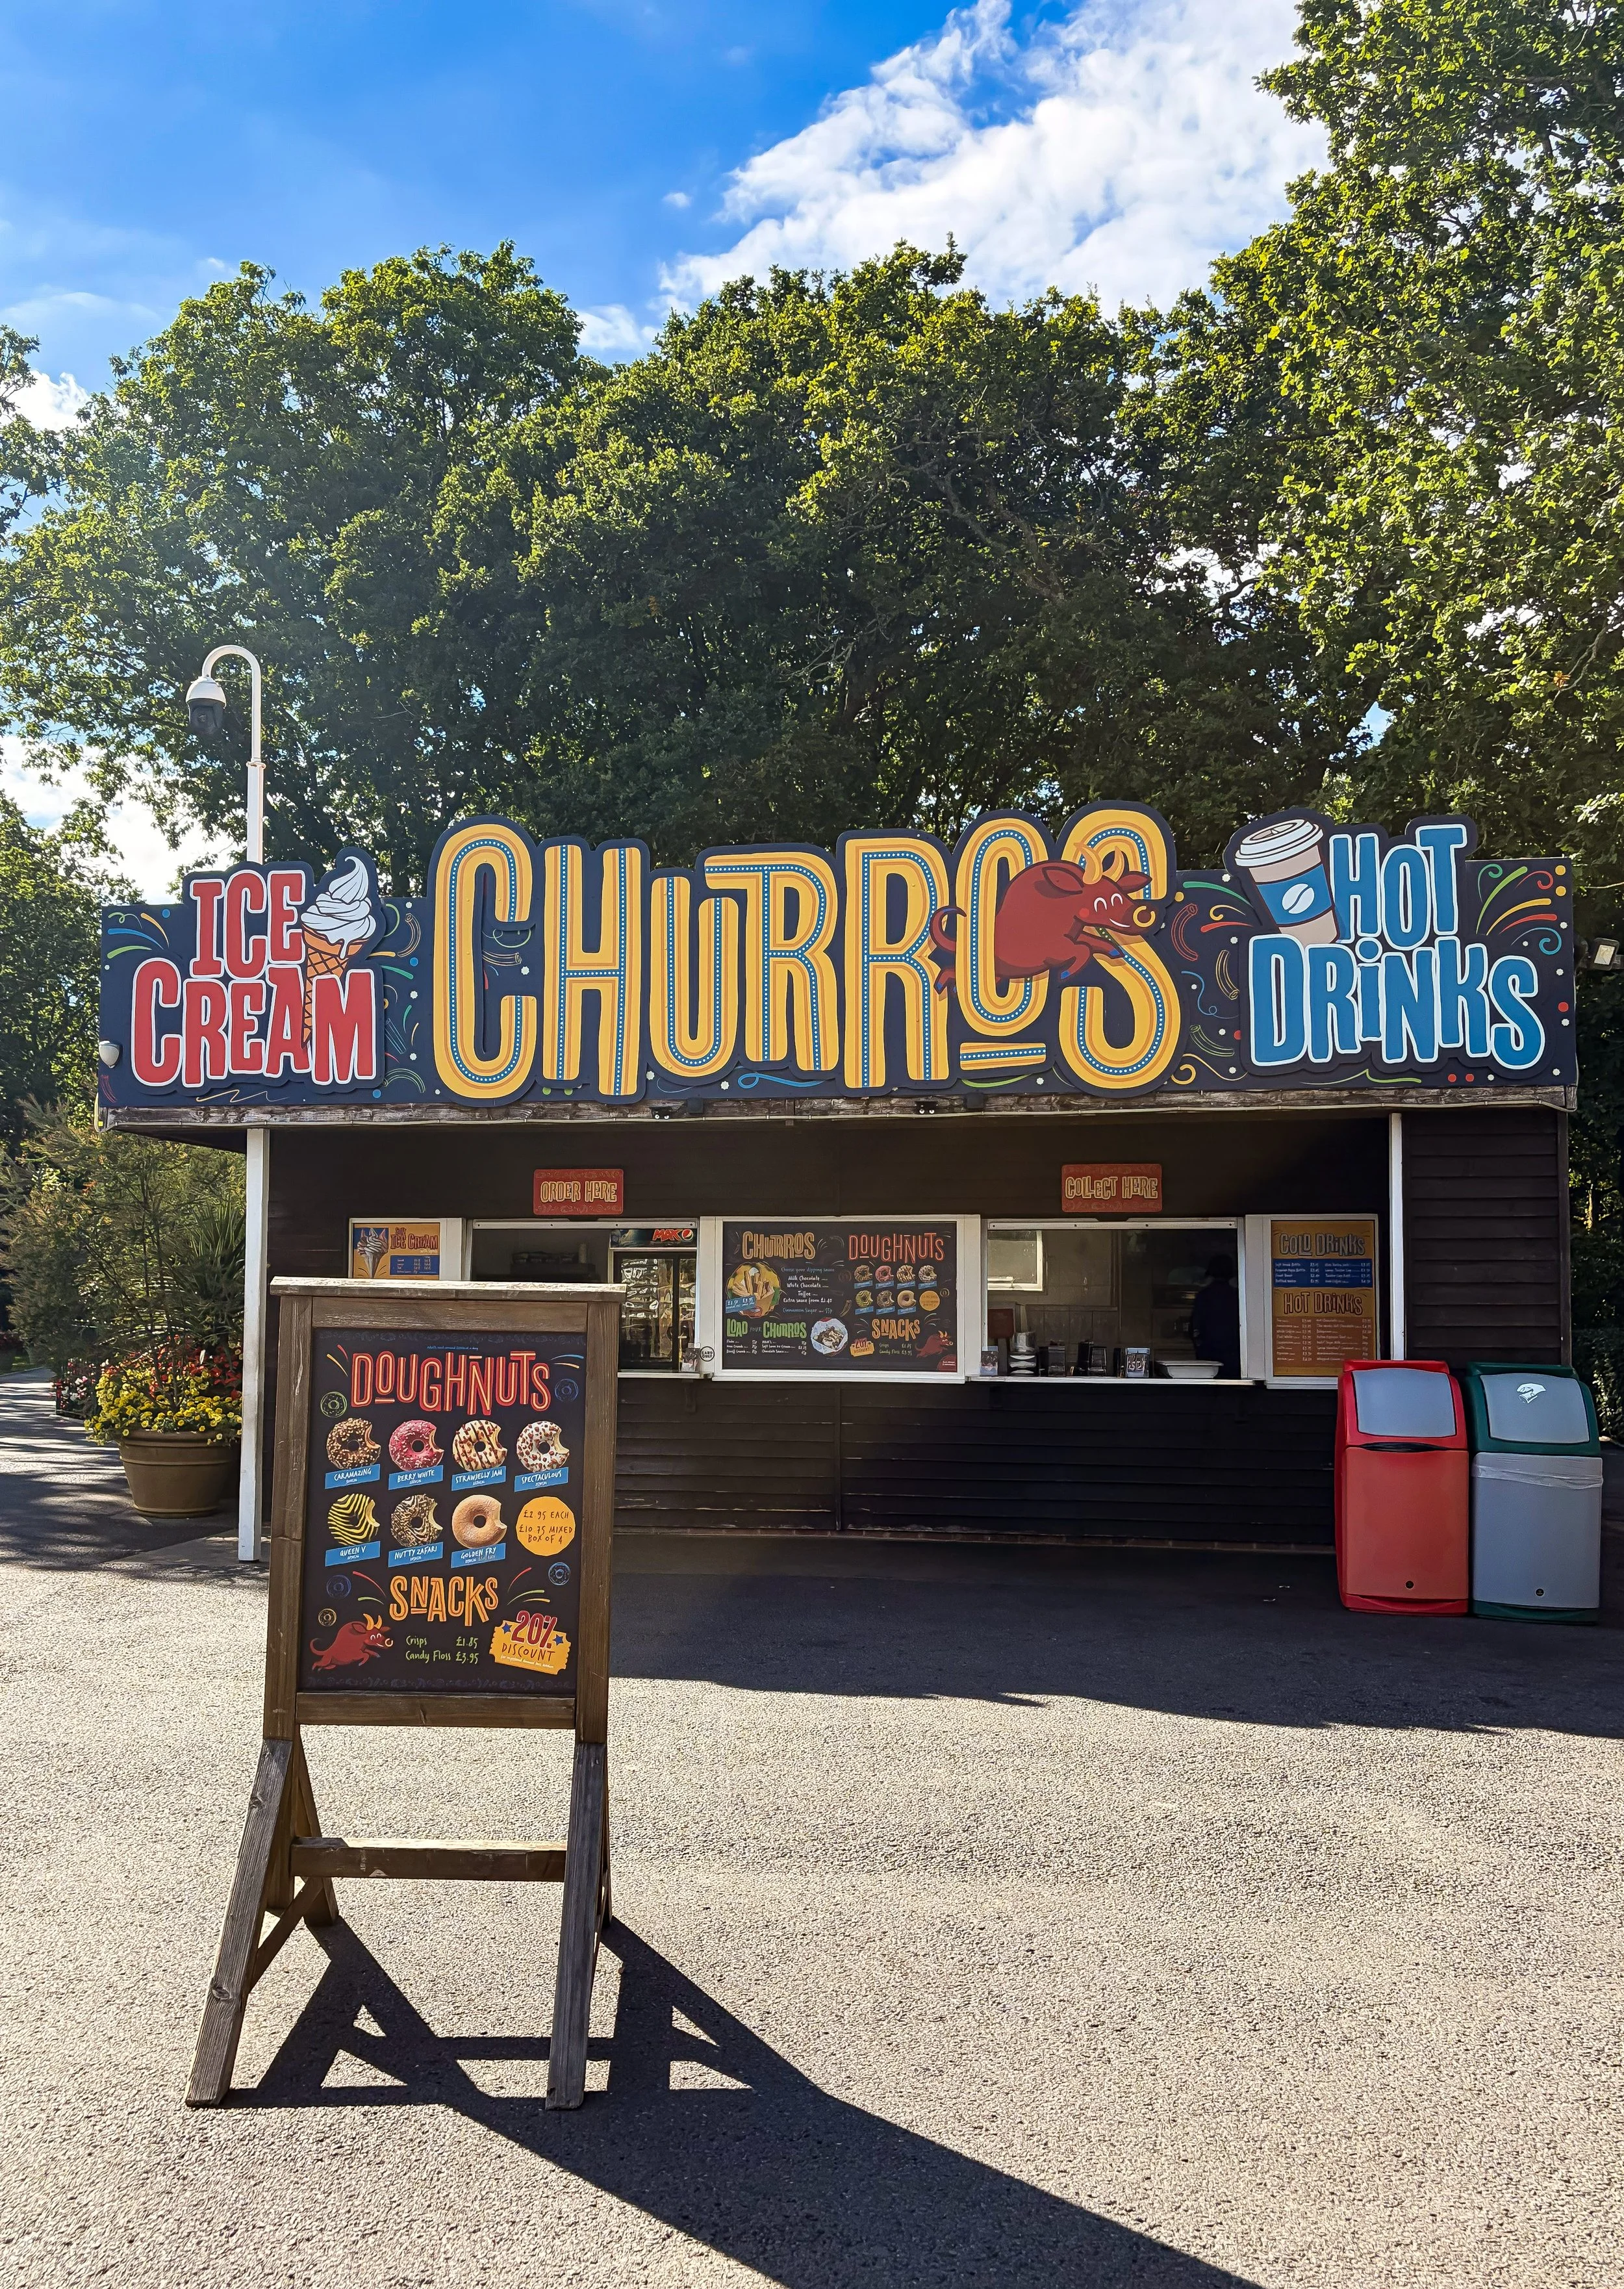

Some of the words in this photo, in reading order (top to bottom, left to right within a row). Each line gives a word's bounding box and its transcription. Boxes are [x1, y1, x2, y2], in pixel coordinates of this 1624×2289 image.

[1329, 824, 1467, 951] HOT
[190, 869, 306, 978] ICE
[433, 810, 1181, 1099] CHURROS
[131, 956, 377, 1087] CREAM
[540, 1181, 581, 1203] ORDER
[585, 1181, 616, 1202] HERE
[1065, 1176, 1117, 1199] COLLECT
[1122, 1177, 1158, 1199] HERE
[390, 1234, 407, 1249] ICE
[408, 1233, 438, 1250] CREAM
[653, 1229, 683, 1242] MAX
[742, 1231, 816, 1260] CHURROS
[1280, 1233, 1312, 1256] COLD
[848, 1233, 945, 1264] DOUGHNUTS
[1284, 1291, 1310, 1314] HOT
[727, 1318, 748, 1337] LOAD
[763, 1321, 807, 1338] CHURROS
[872, 1318, 920, 1341] SNACKS
[351, 1351, 551, 1416] DOUGHNUTS
[334, 1467, 372, 1481] CARAMAZING
[397, 1472, 416, 1483] BERRY
[418, 1469, 435, 1480] WHITE
[455, 1471, 491, 1484] STRAWJELLY
[490, 1469, 503, 1479] JAM
[522, 1470, 563, 1485] SPECTACULOUS
[528, 1534, 542, 1543] BOX
[545, 1535, 556, 1544] OF
[558, 1535, 563, 1544] 4
[340, 1547, 360, 1557] QUEEN
[395, 1549, 416, 1560] NUTTY
[416, 1546, 437, 1555] ZAFARI
[461, 1548, 484, 1559] GOLDEN
[485, 1546, 497, 1556] FRY
[389, 1576, 499, 1626] SNACKS
[511, 1610, 557, 1649] 20%
[406, 1635, 427, 1650] Crisps
[456, 1637, 479, 1649] £1.85
[501, 1643, 555, 1662] DISCOUNT
[405, 1650, 429, 1663] Candy
[433, 1650, 451, 1661] Floss
[455, 1652, 479, 1664] £3.95
